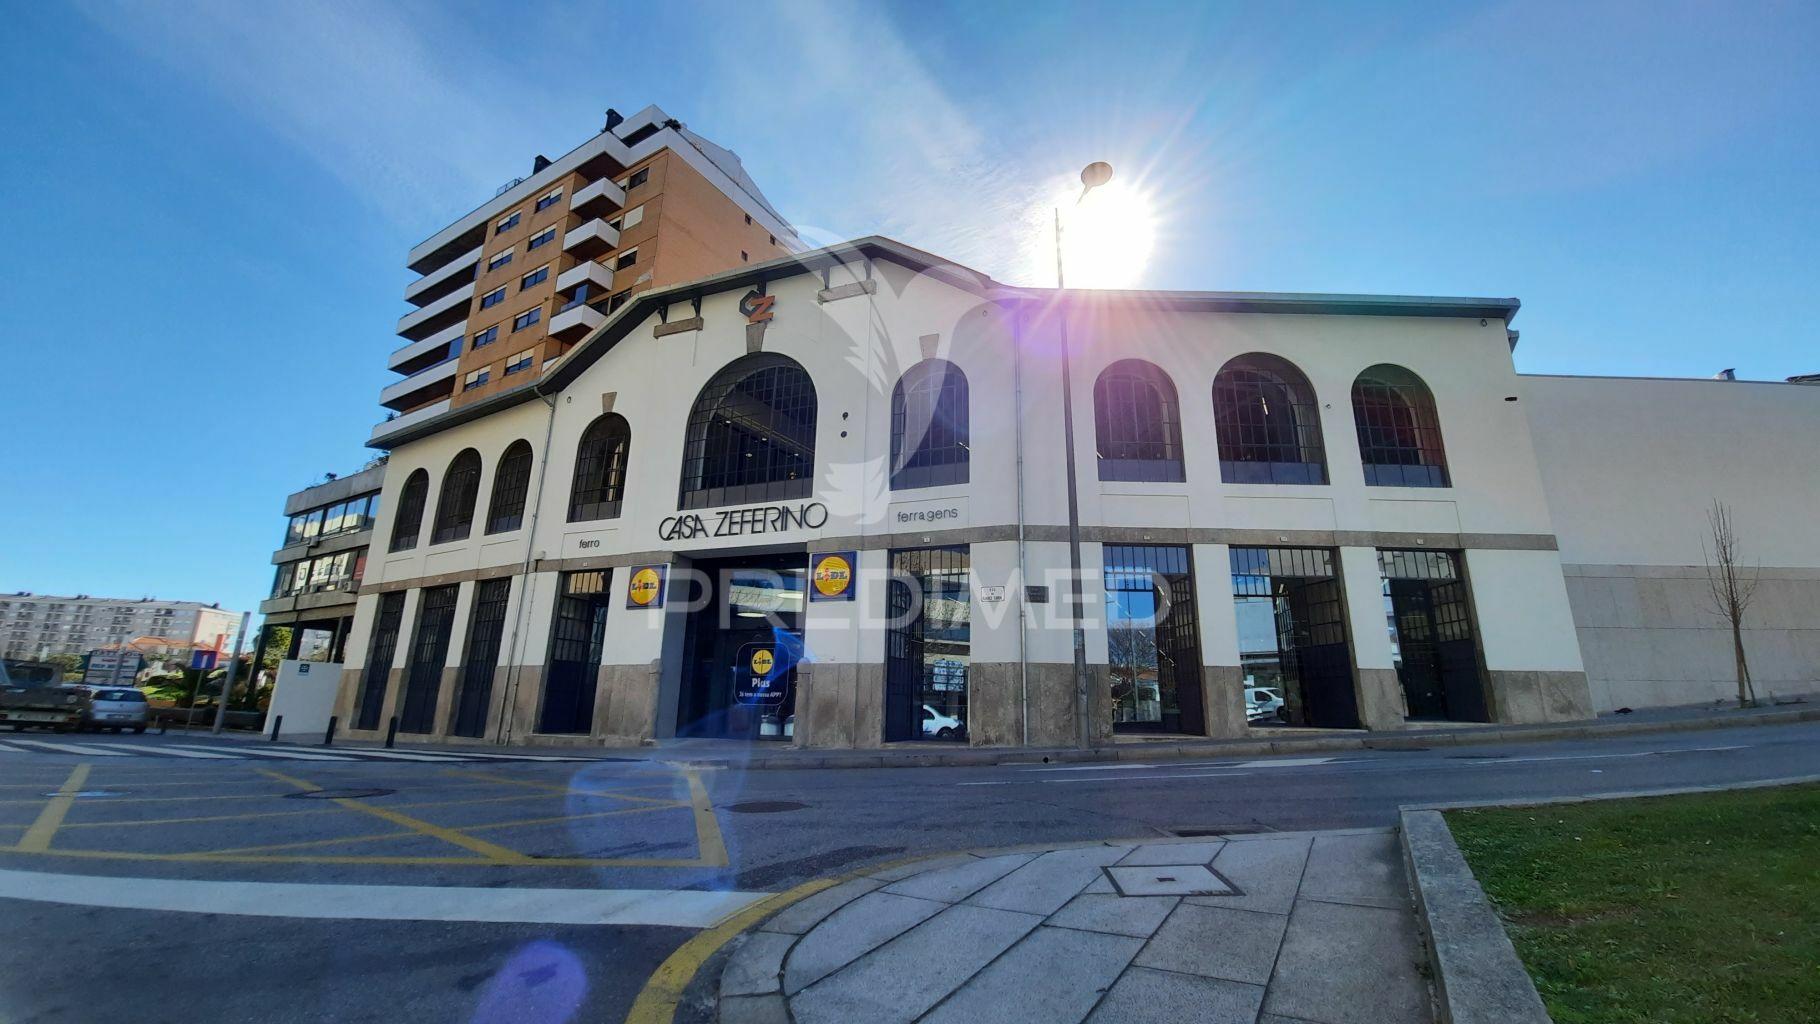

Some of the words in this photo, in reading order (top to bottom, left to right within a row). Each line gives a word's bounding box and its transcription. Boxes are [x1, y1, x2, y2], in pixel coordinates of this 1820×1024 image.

[897, 508, 958, 522] ferragens
[658, 513, 708, 541] CASA
[713, 502, 828, 537] ZEFERINO
[579, 539, 600, 549] ferro
[752, 678, 770, 687] Plus
